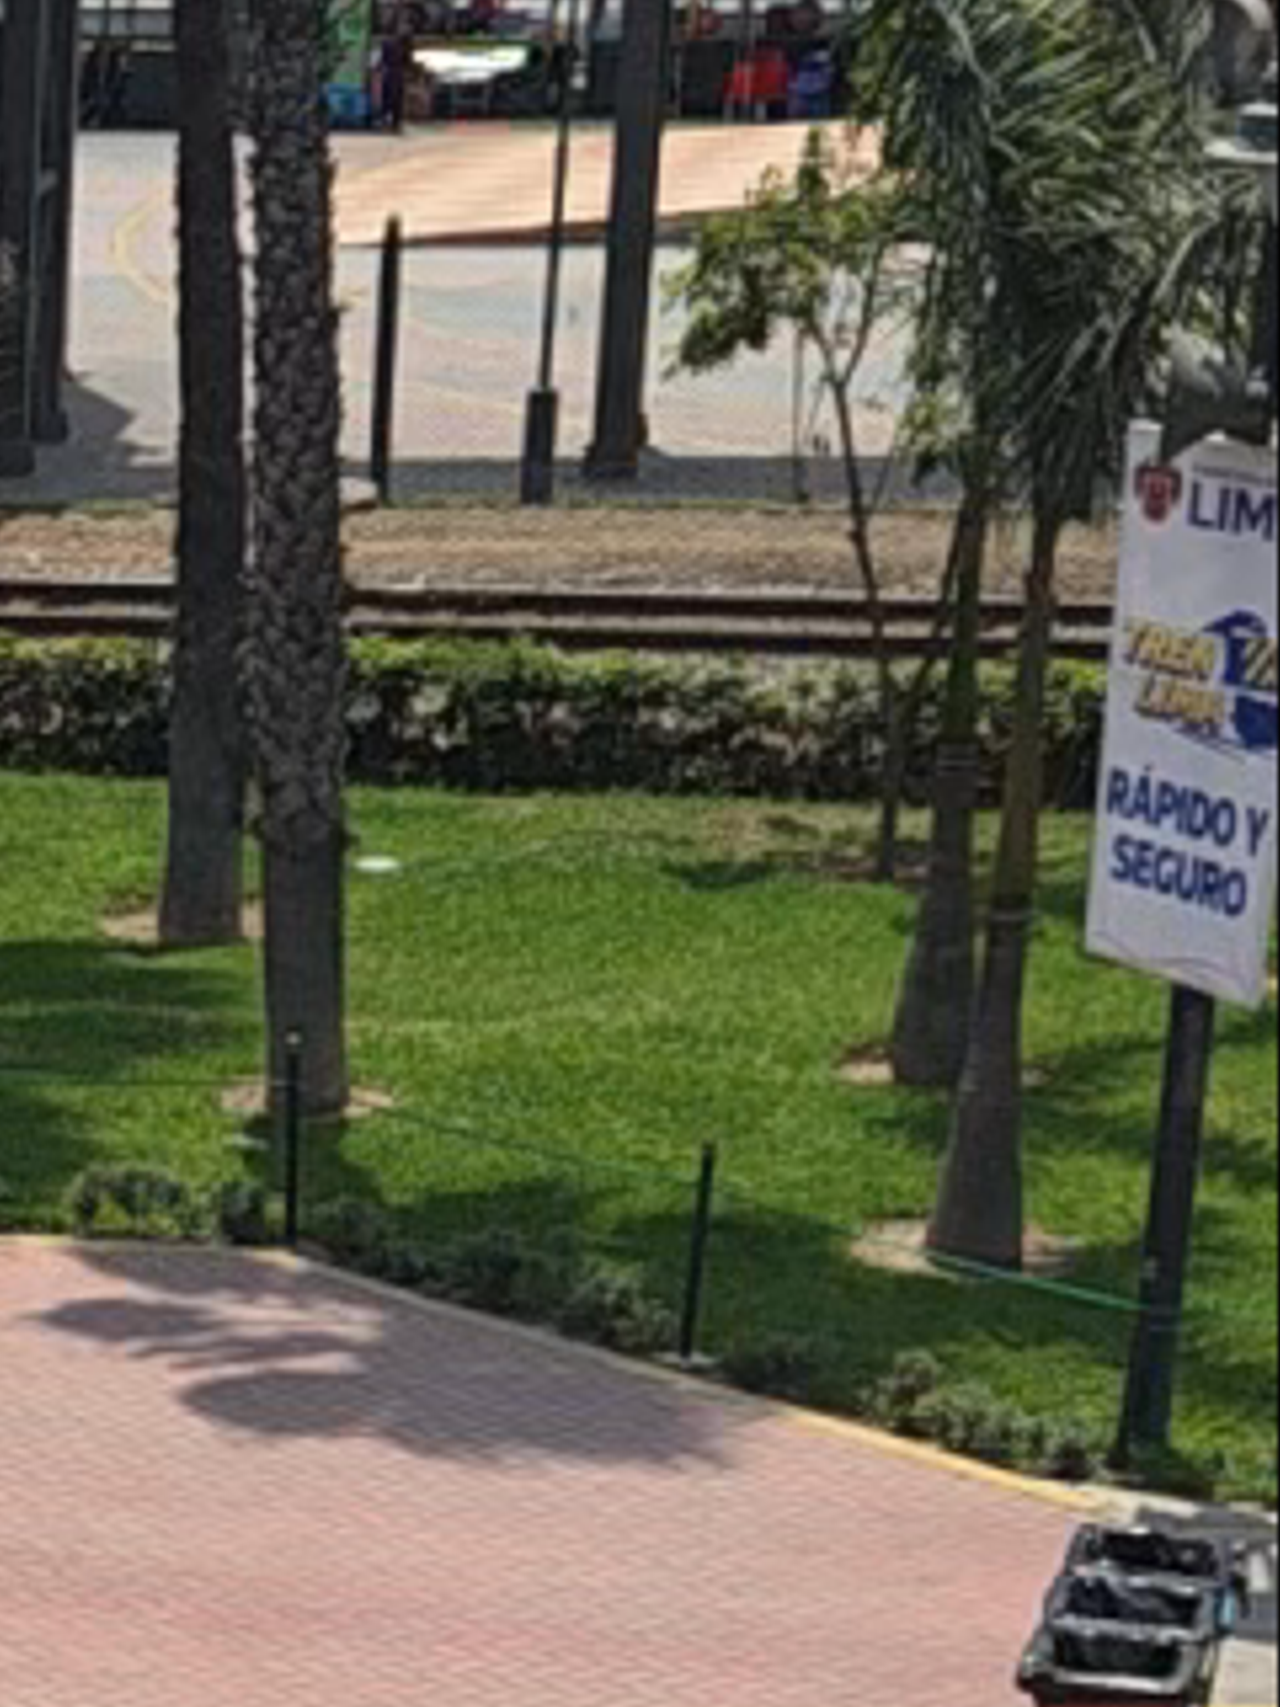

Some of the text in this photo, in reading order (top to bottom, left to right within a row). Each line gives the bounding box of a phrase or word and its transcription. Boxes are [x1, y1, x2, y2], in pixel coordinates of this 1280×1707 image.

[1105, 764, 1271, 858] RÁPIDO Y
[1110, 833, 1248, 917] SEGURO
